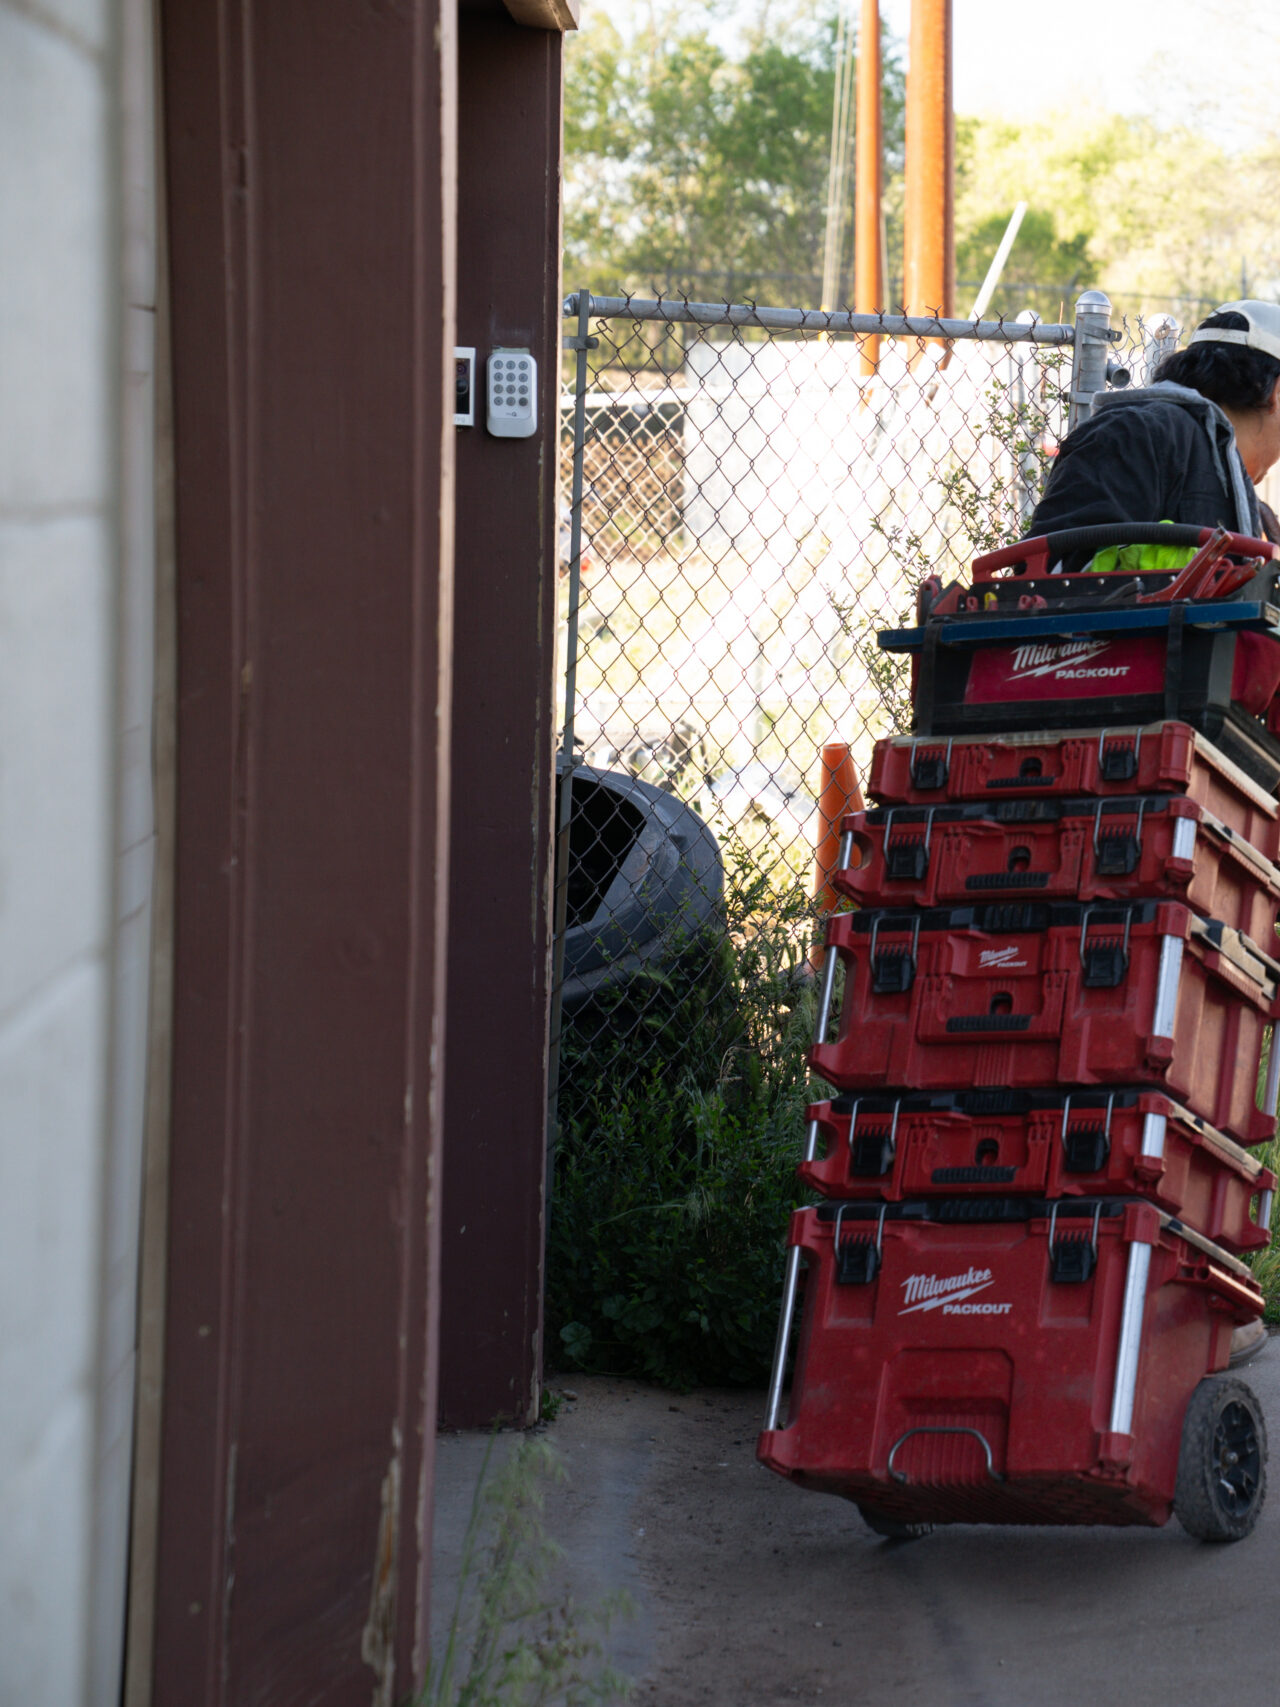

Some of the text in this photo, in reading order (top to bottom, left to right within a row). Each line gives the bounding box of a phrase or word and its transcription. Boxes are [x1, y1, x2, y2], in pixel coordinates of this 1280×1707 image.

[1055, 666, 1131, 679] PACKOUT
[900, 1266, 993, 1305] Milwaukee
[942, 1303, 1013, 1315] PACKOUT
